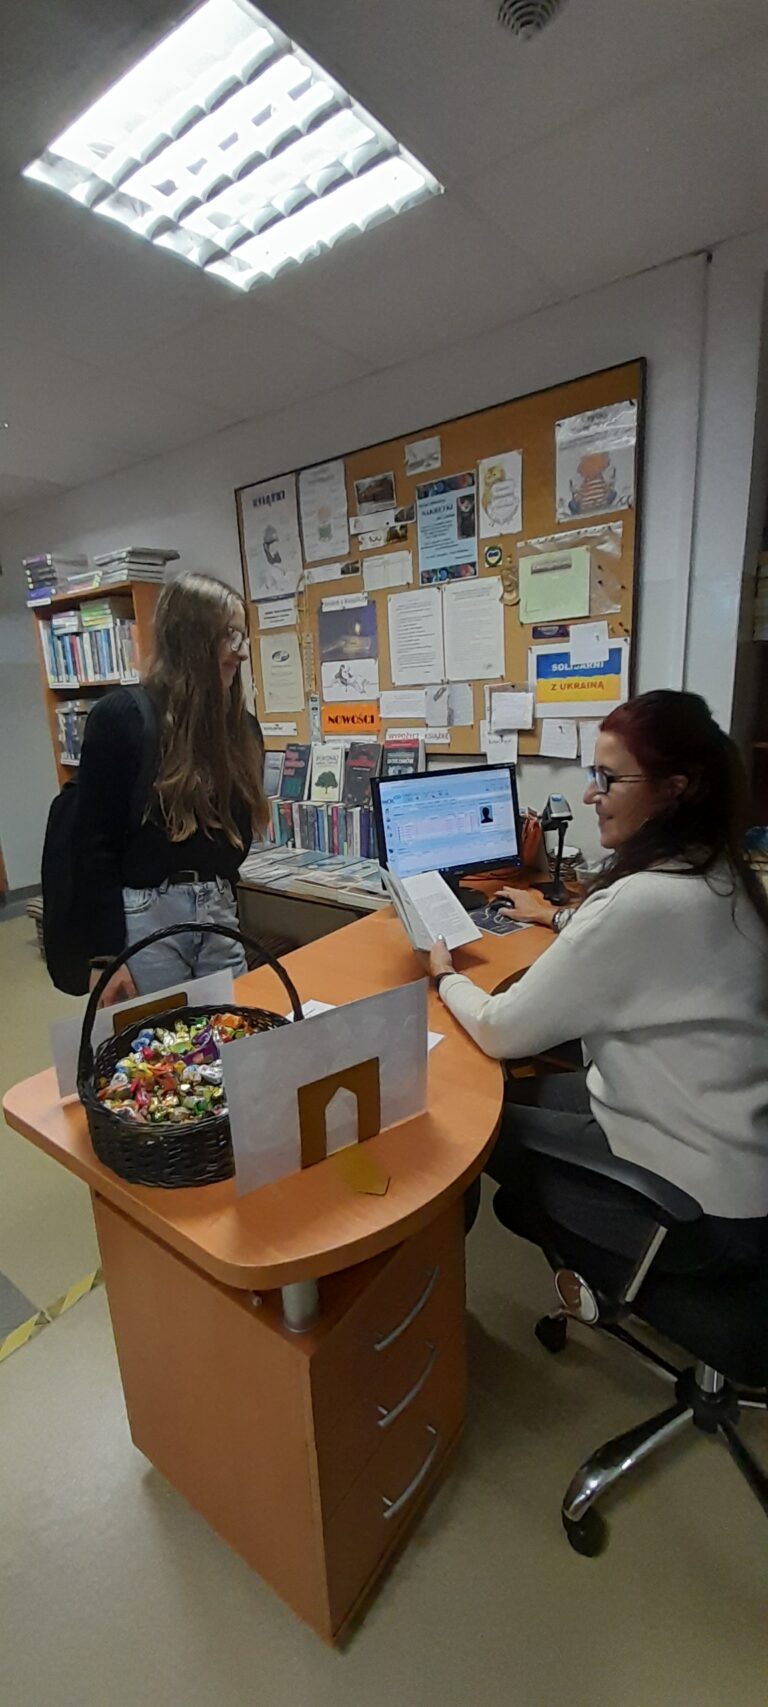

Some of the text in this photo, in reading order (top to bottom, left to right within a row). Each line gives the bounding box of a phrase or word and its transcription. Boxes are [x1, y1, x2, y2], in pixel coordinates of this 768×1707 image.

[551, 680, 605, 691] Z UKRAINĄ
[327, 712, 375, 724] NOWOŚCI
